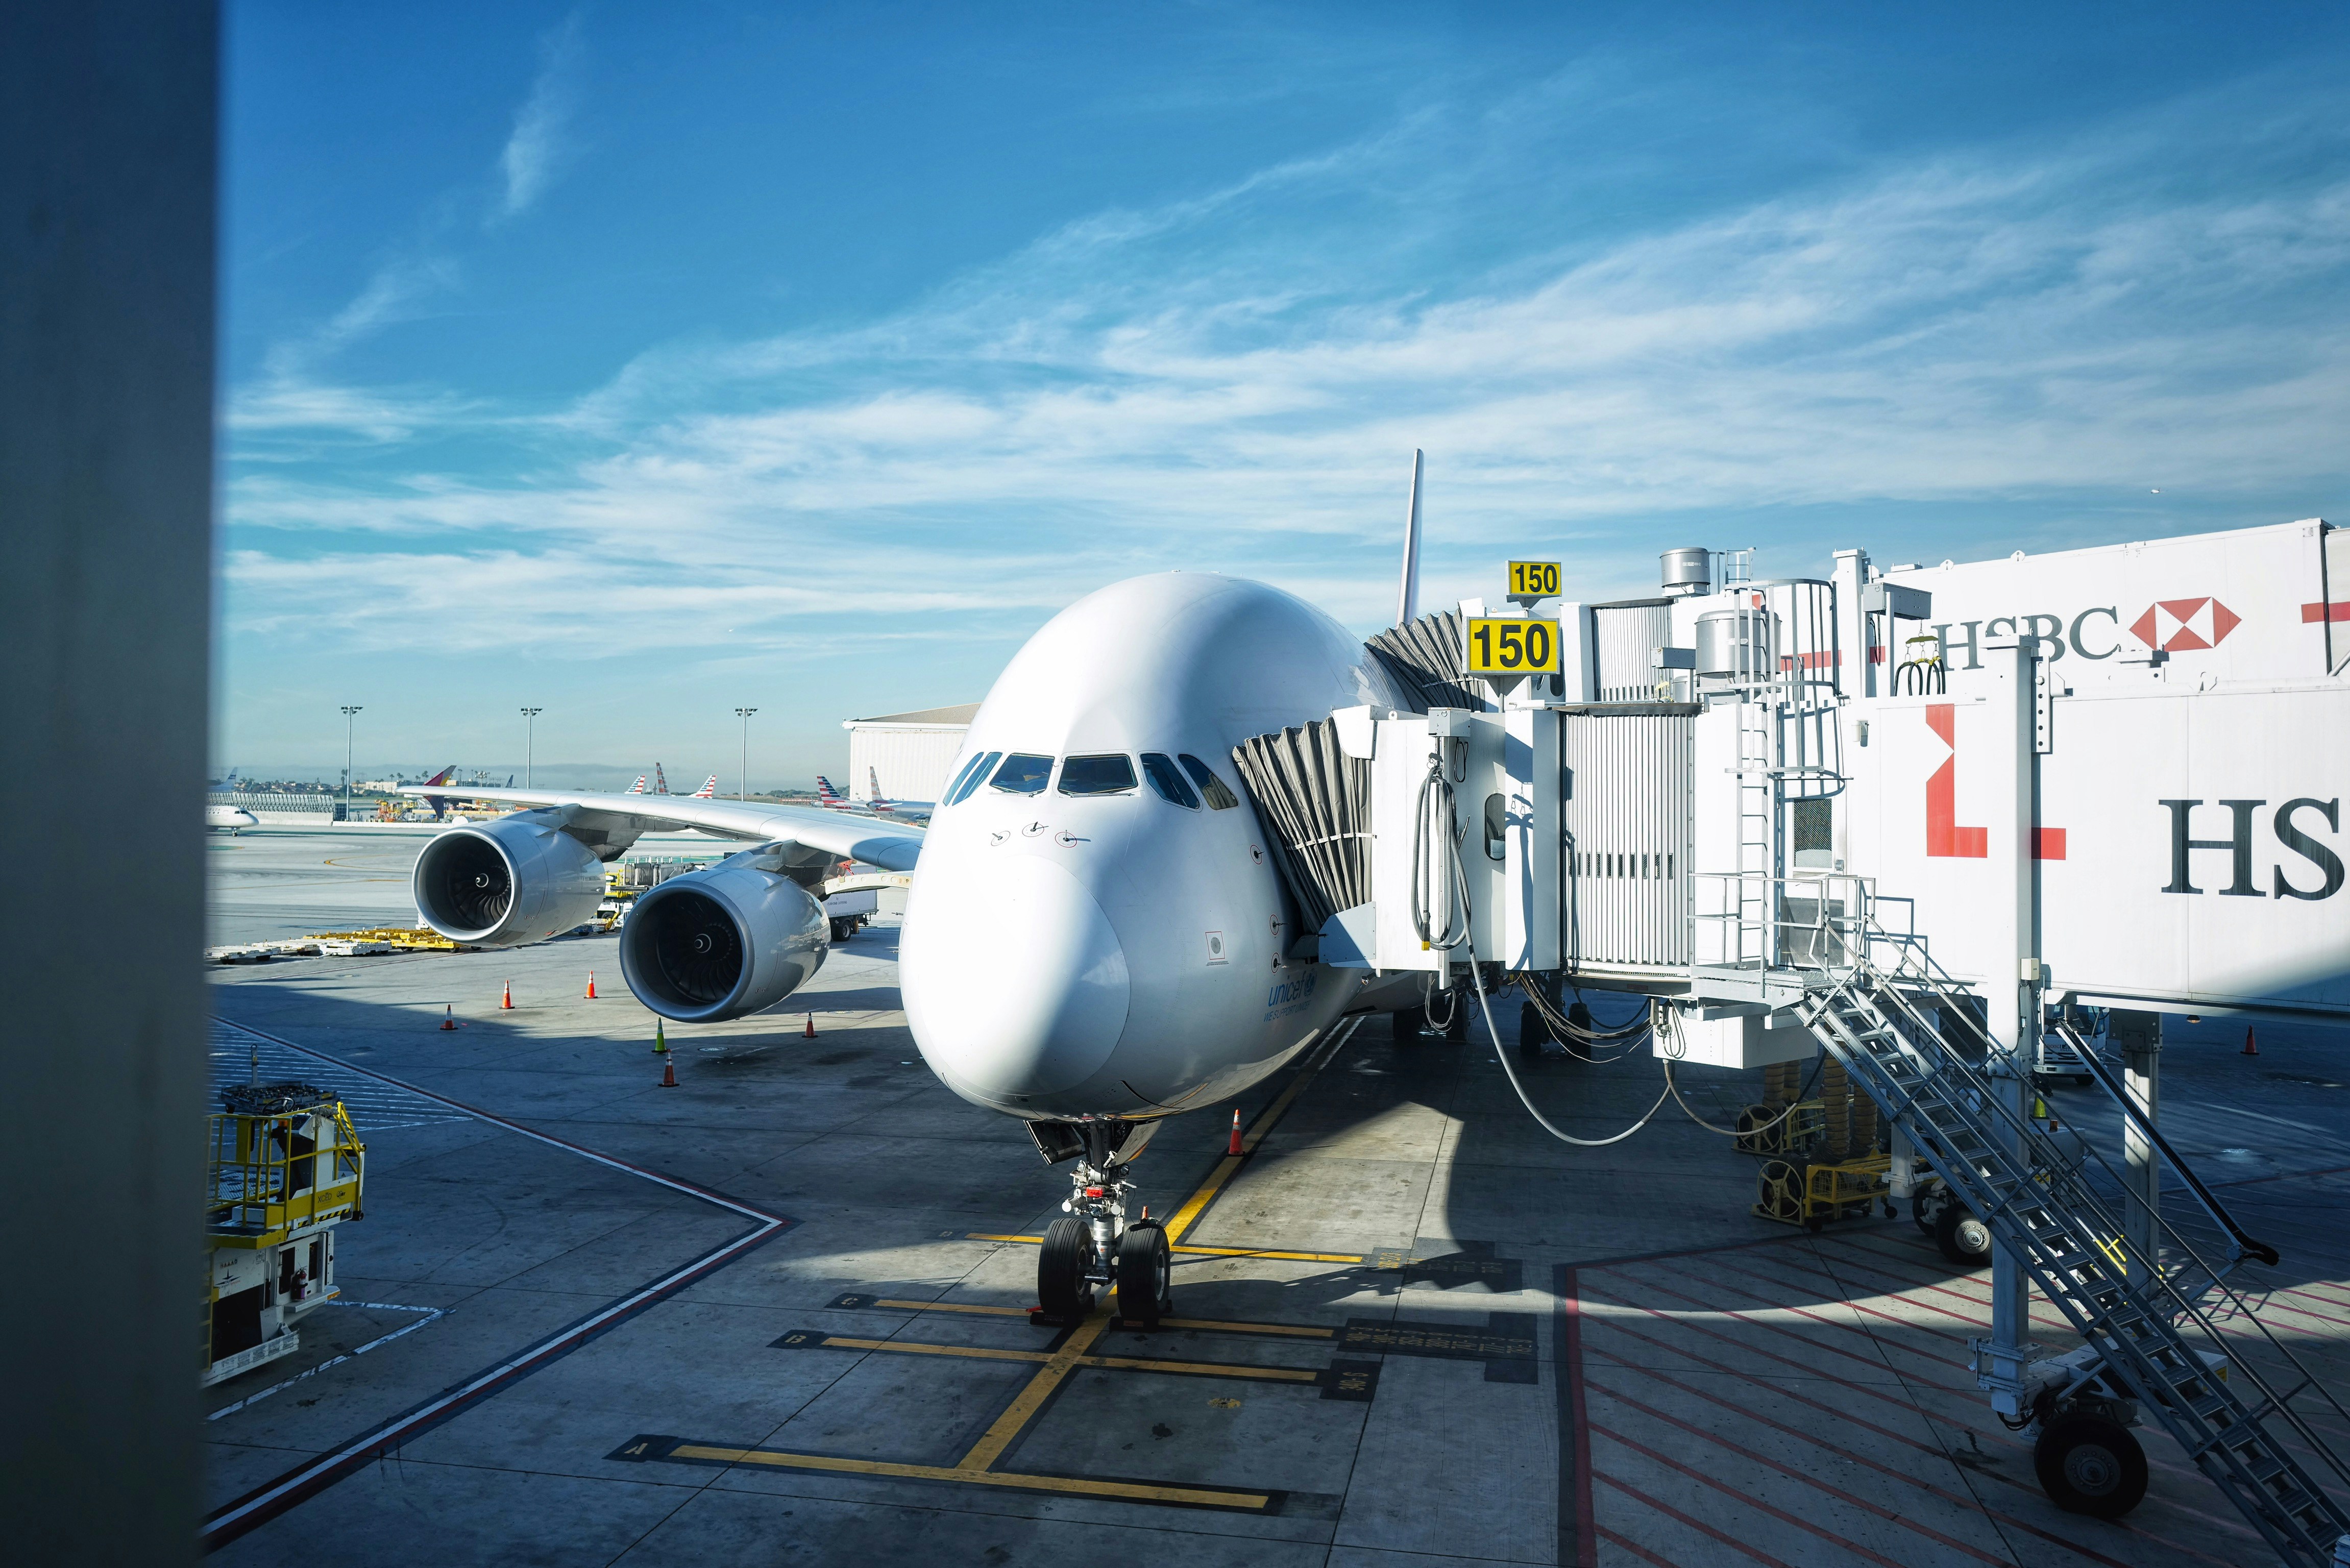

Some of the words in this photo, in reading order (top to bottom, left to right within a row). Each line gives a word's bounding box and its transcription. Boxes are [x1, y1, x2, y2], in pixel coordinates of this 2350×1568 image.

[1515, 565, 1557, 593] 150
[1474, 623, 1550, 668] 150
[2159, 798, 2350, 900] HS
[1268, 970, 1307, 1007] unicef
[1263, 1011, 1274, 1022] WE
[1273, 1005, 1296, 1020] SUPPORT
[317, 1193, 332, 1203] XCED
[785, 1335, 806, 1343] B
[1339, 1372, 1369, 1391] 340-6
[624, 1442, 648, 1455] A
